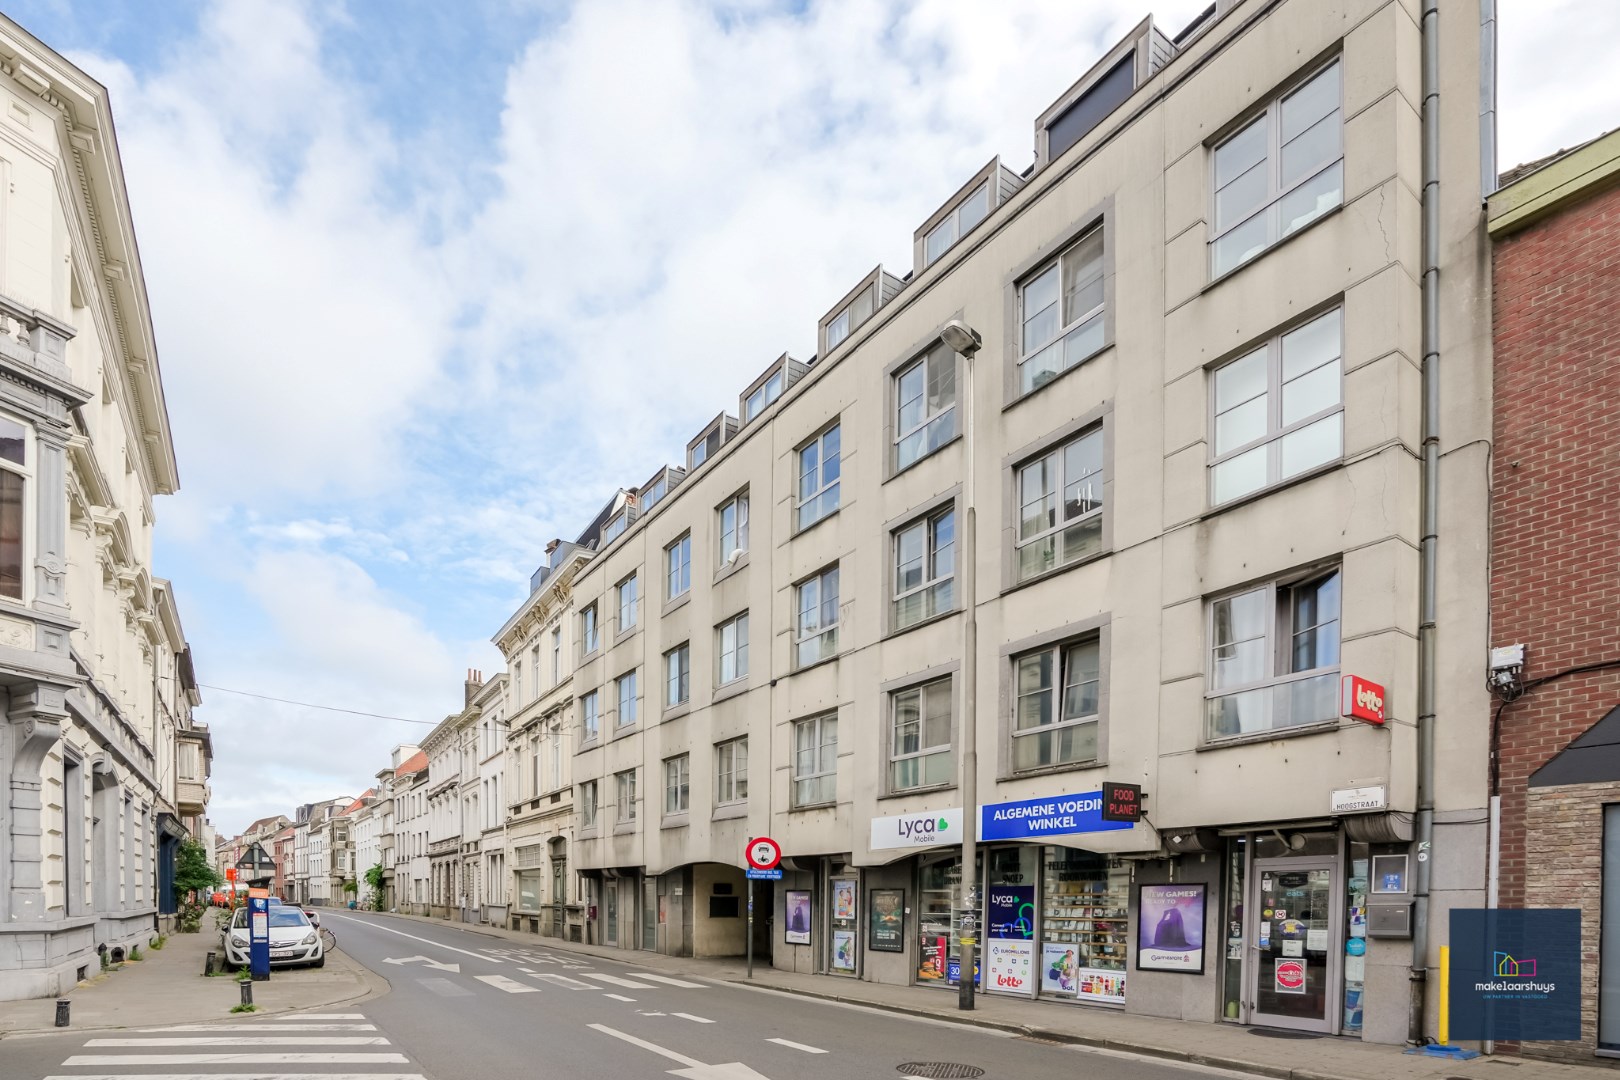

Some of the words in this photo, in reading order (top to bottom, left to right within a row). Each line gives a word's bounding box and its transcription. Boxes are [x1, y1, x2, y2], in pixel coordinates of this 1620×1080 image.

[1113, 789, 1135, 801] FOOD
[993, 804, 1055, 821] ALGEMENE
[1057, 798, 1103, 814] VOEDIN
[1109, 803, 1138, 815] PLANET
[1336, 800, 1379, 810] HOOGSTRAAT
[898, 818, 935, 839] Lyca
[1027, 815, 1077, 831] WINKEL
[913, 834, 935, 843] Mobile
[991, 894, 1013, 905] Lyca
[1165, 890, 1198, 898] GAMES!
